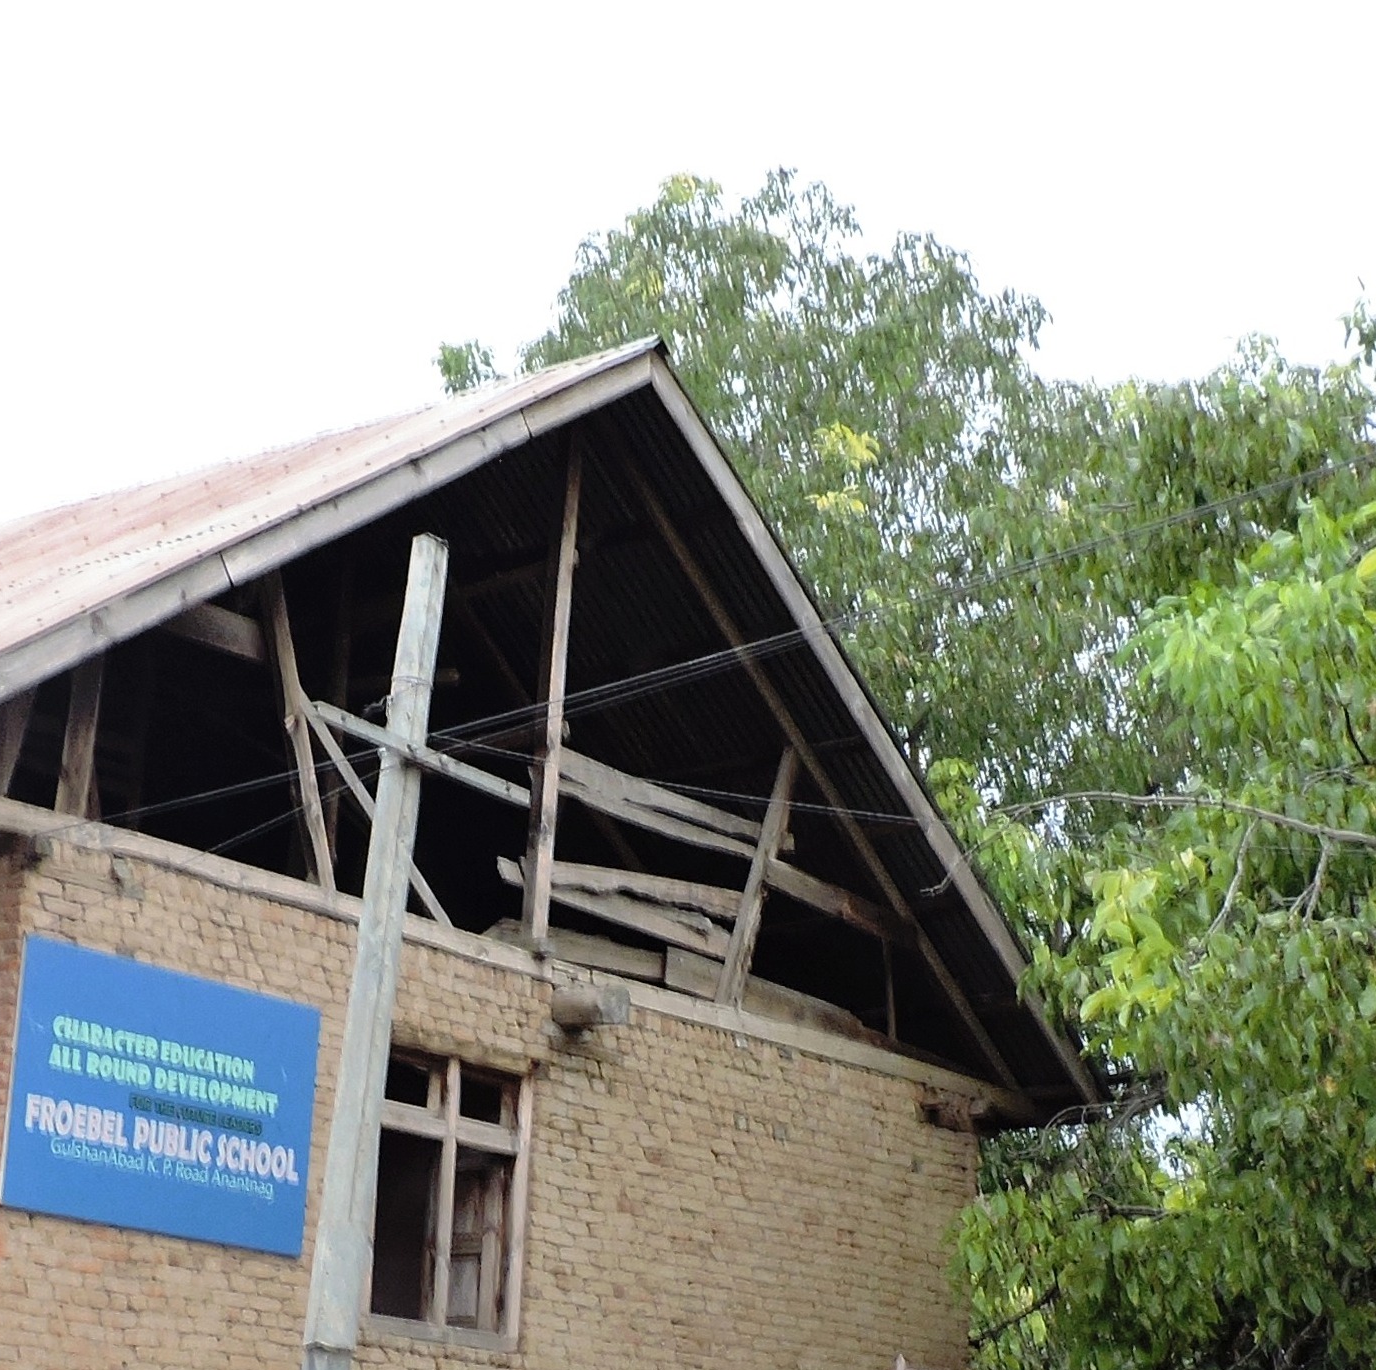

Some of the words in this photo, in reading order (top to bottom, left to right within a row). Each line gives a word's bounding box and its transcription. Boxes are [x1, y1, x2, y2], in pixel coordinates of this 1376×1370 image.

[49, 1043, 82, 1073] ALL
[87, 1052, 152, 1087] ROUND
[154, 1067, 279, 1117] DEVELOPMENT
[52, 1015, 158, 1060] CHARACTER
[160, 1039, 256, 1084] EDUCATION
[25, 1093, 128, 1149] FROEBEL
[133, 1116, 213, 1166] PUBLIC
[216, 1134, 300, 1184] SCHOOL
[175, 1163, 210, 1184] Road
[211, 1171, 274, 1200] Anantnag
